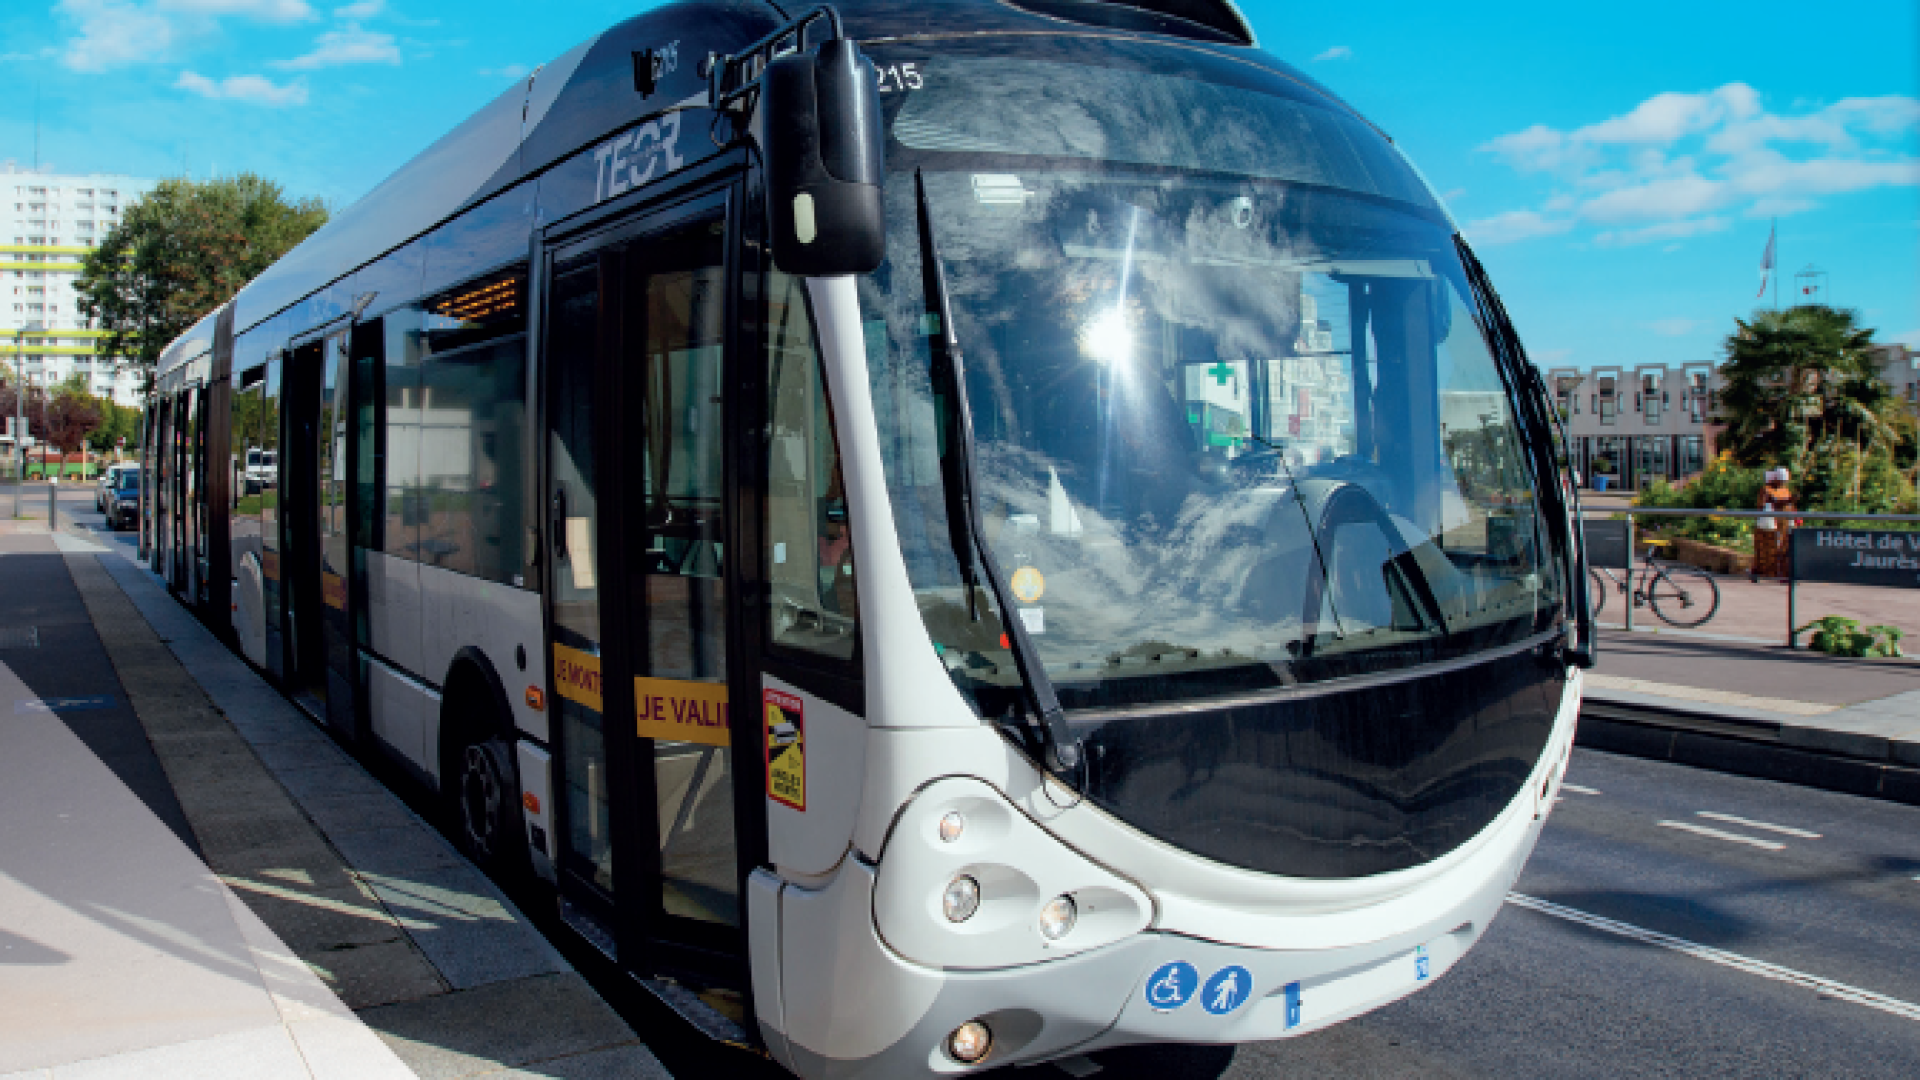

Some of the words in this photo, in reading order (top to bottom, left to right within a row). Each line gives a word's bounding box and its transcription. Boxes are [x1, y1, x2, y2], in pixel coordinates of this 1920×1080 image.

[1816, 530, 1872, 549] Hôtel
[1877, 533, 1903, 551] de
[556, 658, 567, 681] JE
[639, 694, 667, 720] JE
